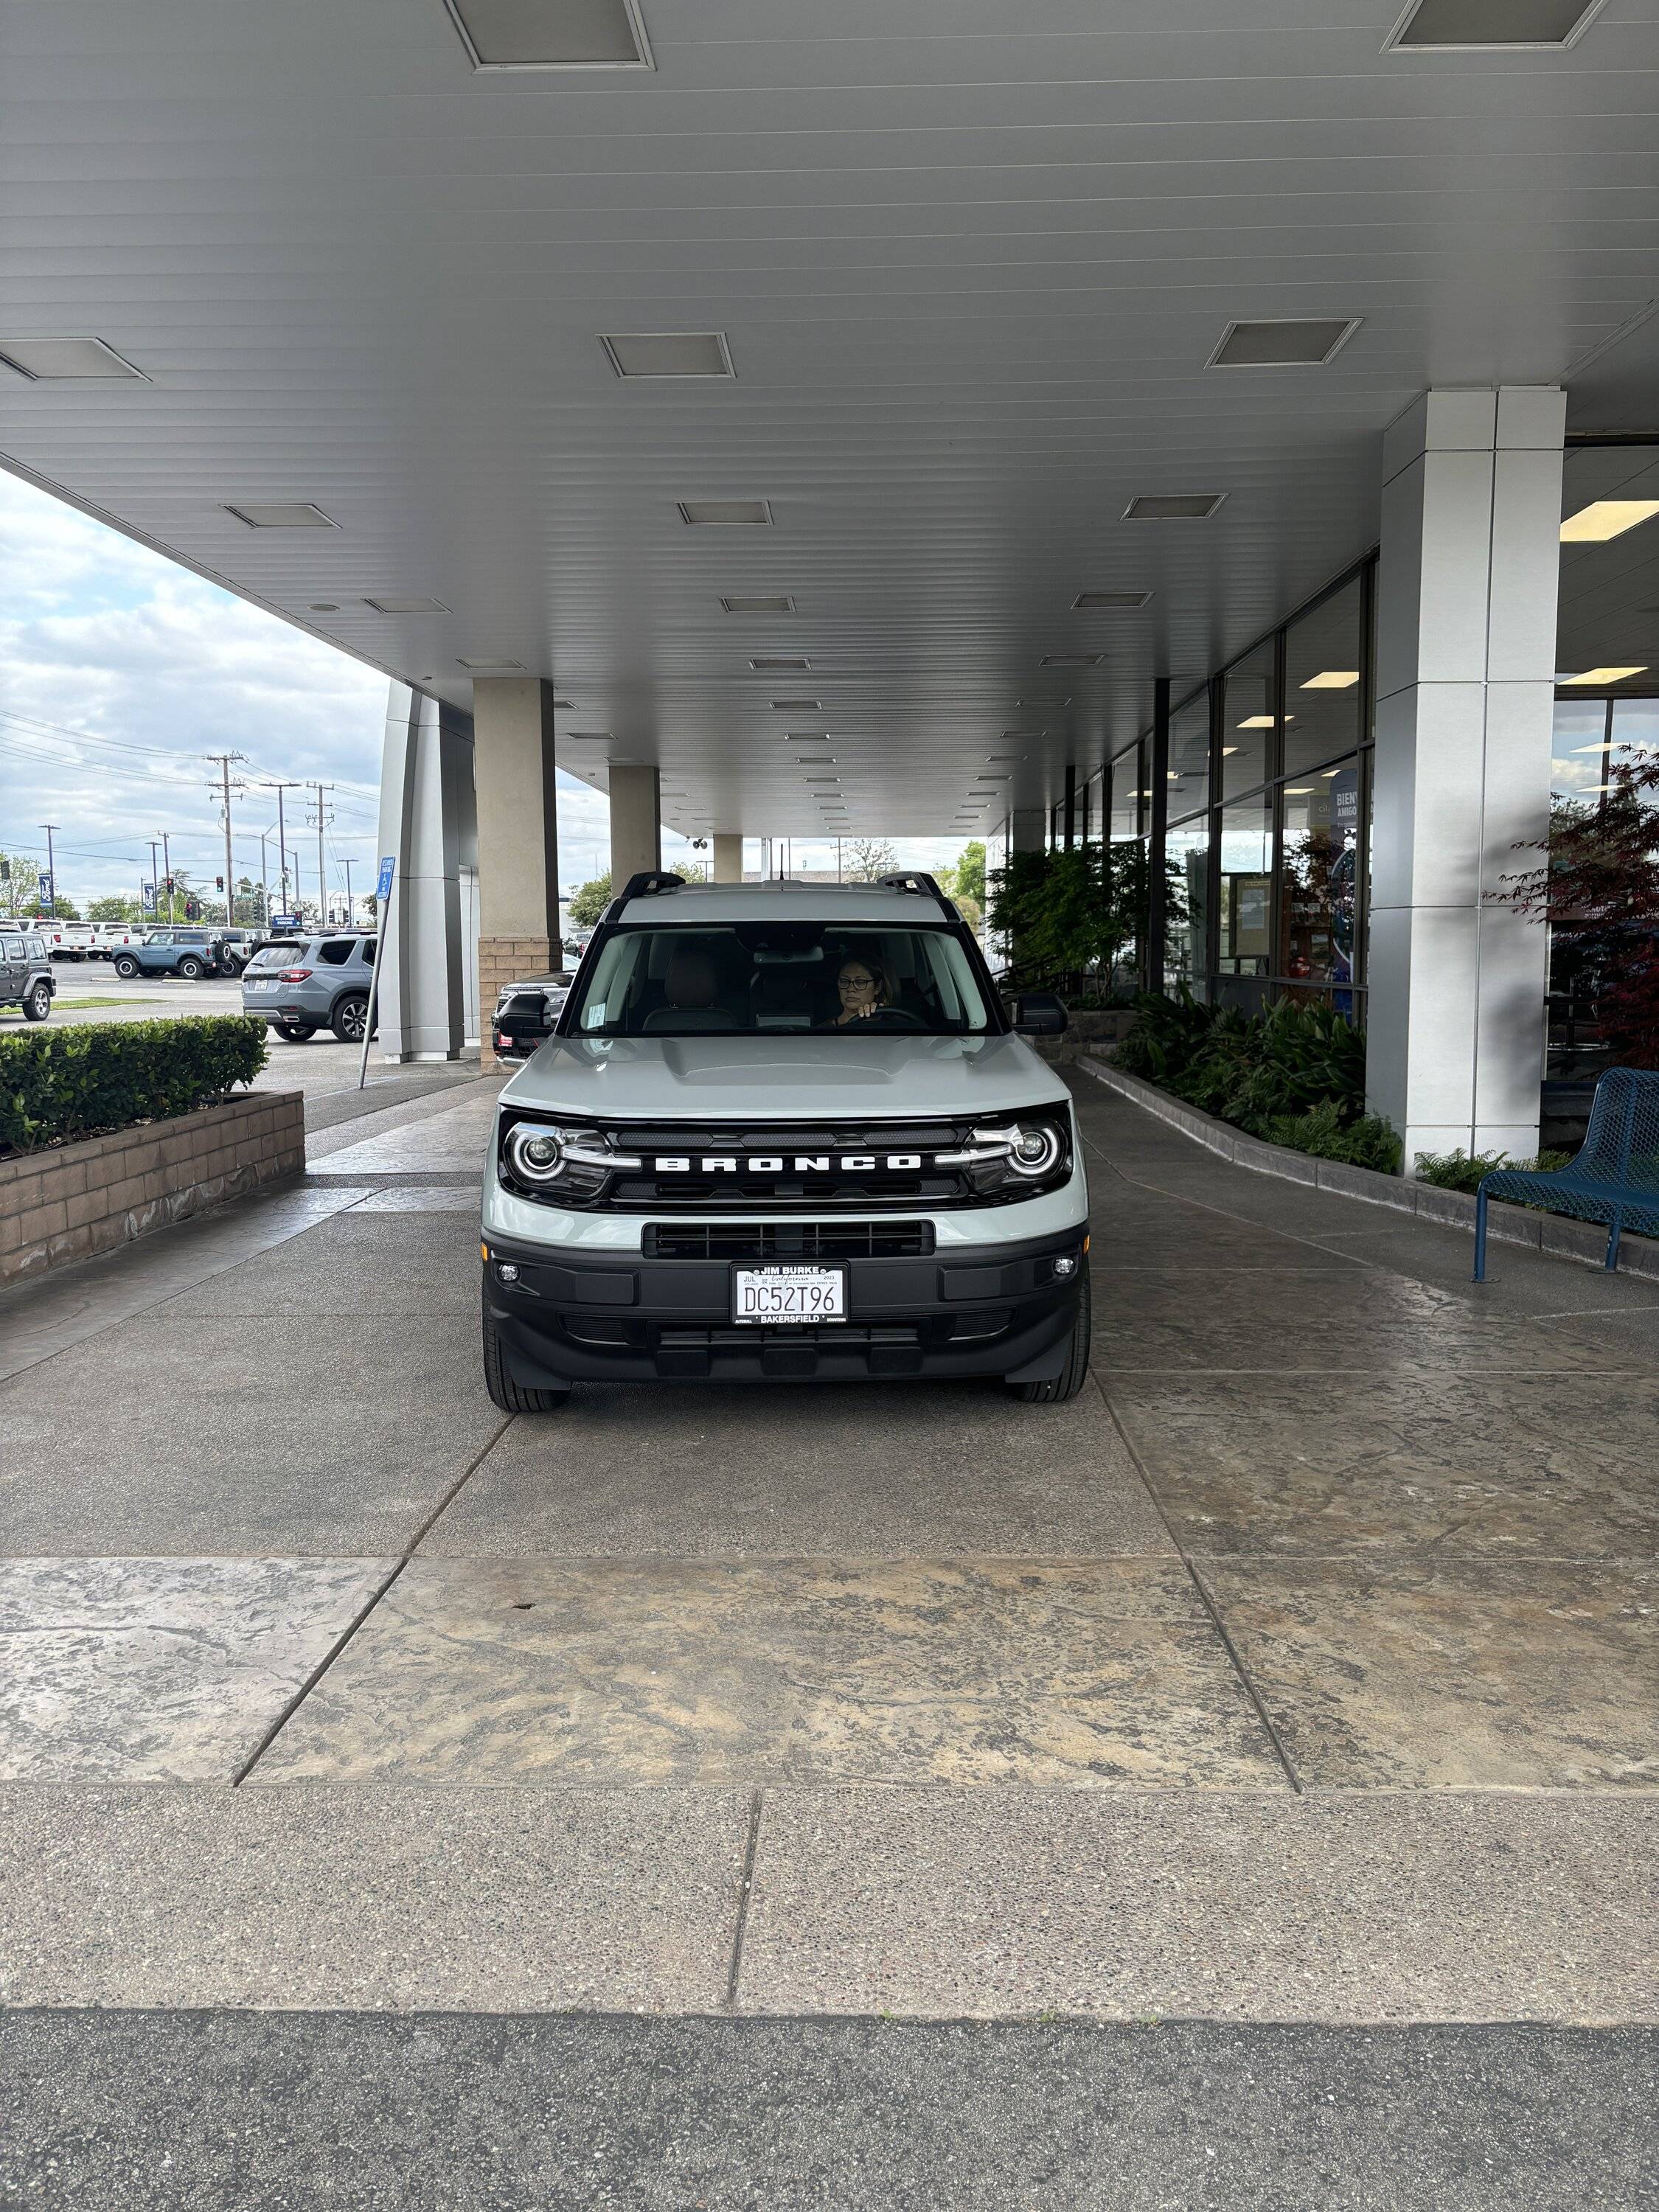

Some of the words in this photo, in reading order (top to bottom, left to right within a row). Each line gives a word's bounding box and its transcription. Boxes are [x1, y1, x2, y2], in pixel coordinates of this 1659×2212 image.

[42, 878, 51, 902] Ford
[145, 888, 154, 908] Ford
[655, 1155, 921, 1172] BRONCO
[761, 1267, 779, 1275] JIM
[782, 1266, 819, 1274] BURKE
[771, 1275, 809, 1284] California
[745, 1287, 835, 1312] DC52T96
[760, 1315, 820, 1324] BAKERSFIELD
